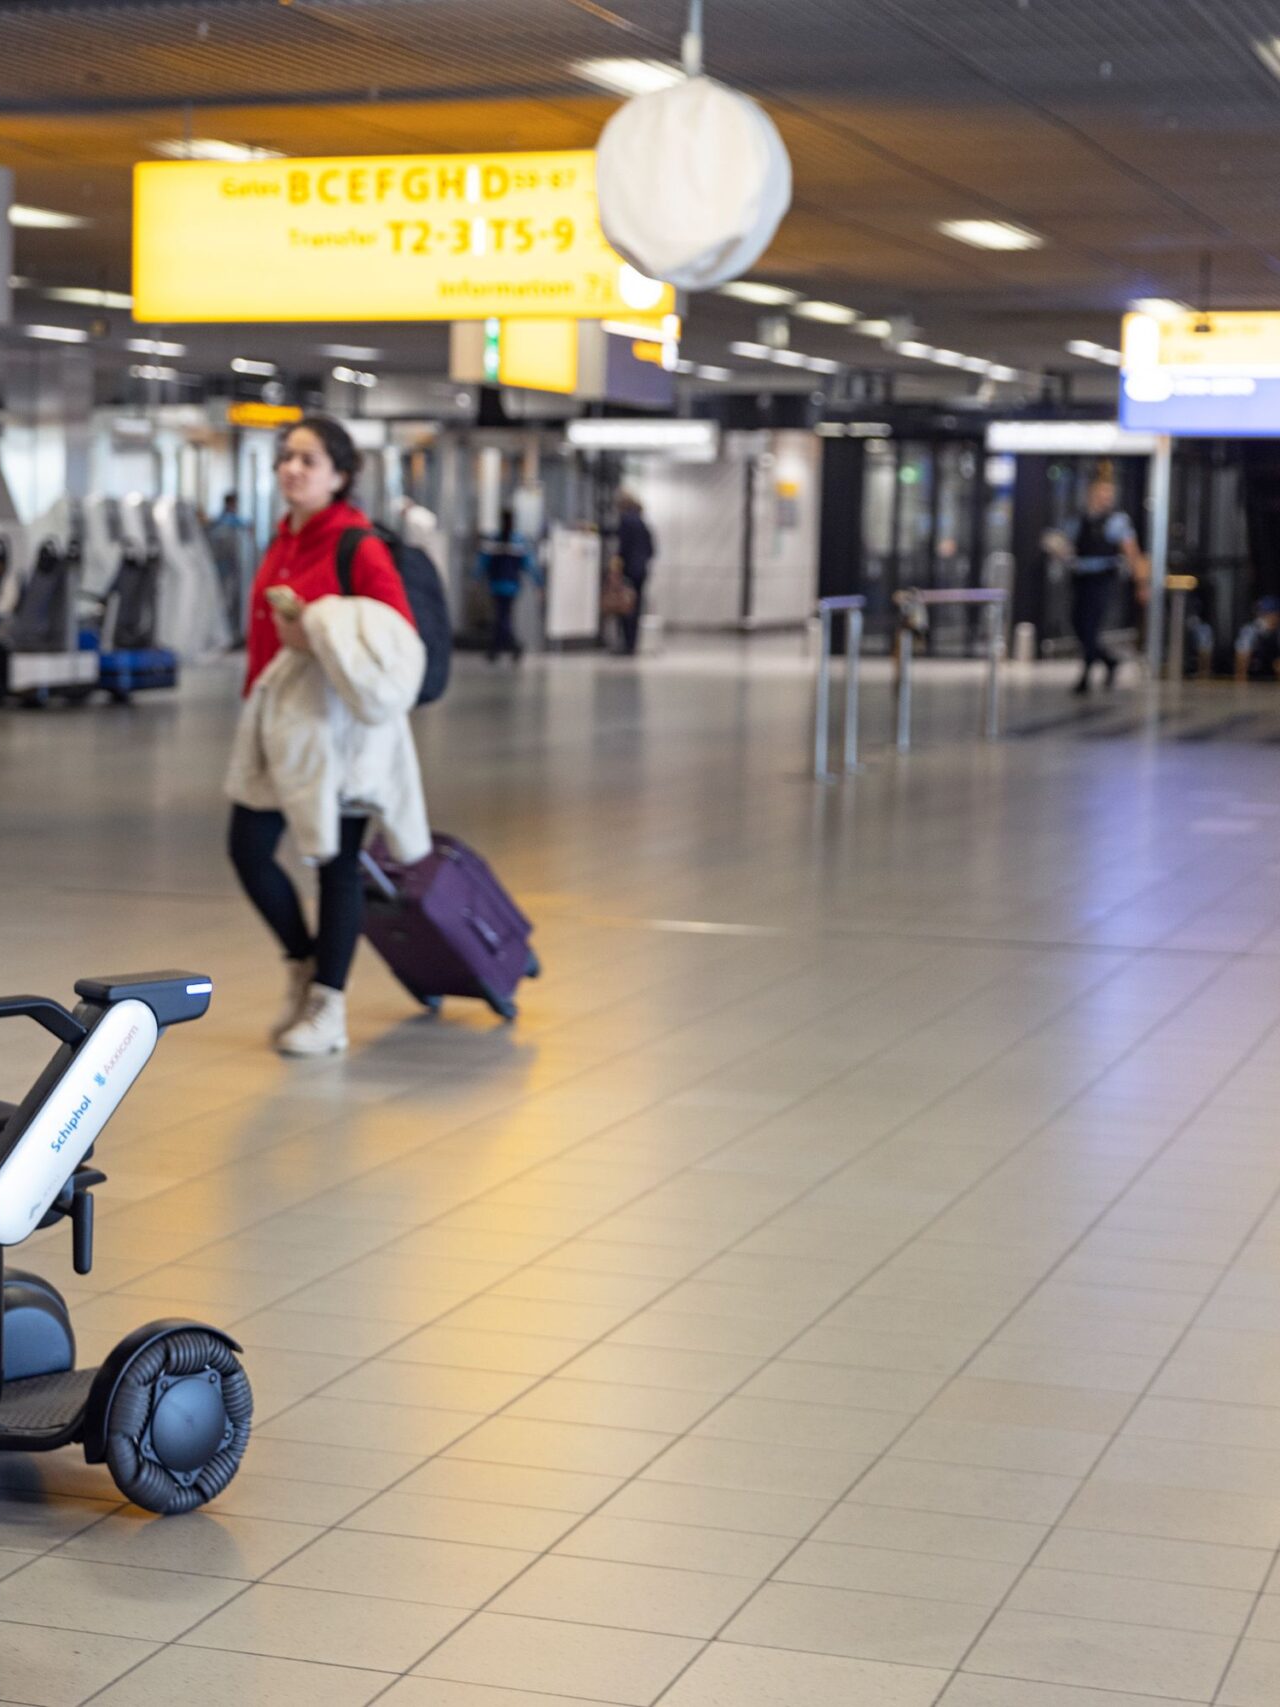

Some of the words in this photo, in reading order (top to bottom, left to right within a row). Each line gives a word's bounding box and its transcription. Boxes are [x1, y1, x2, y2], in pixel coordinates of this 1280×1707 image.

[222, 177, 282, 198] Gates
[289, 227, 377, 247] Transfer
[51, 1094, 92, 1153] Schiphol
[103, 1024, 139, 1076] Axxicom
